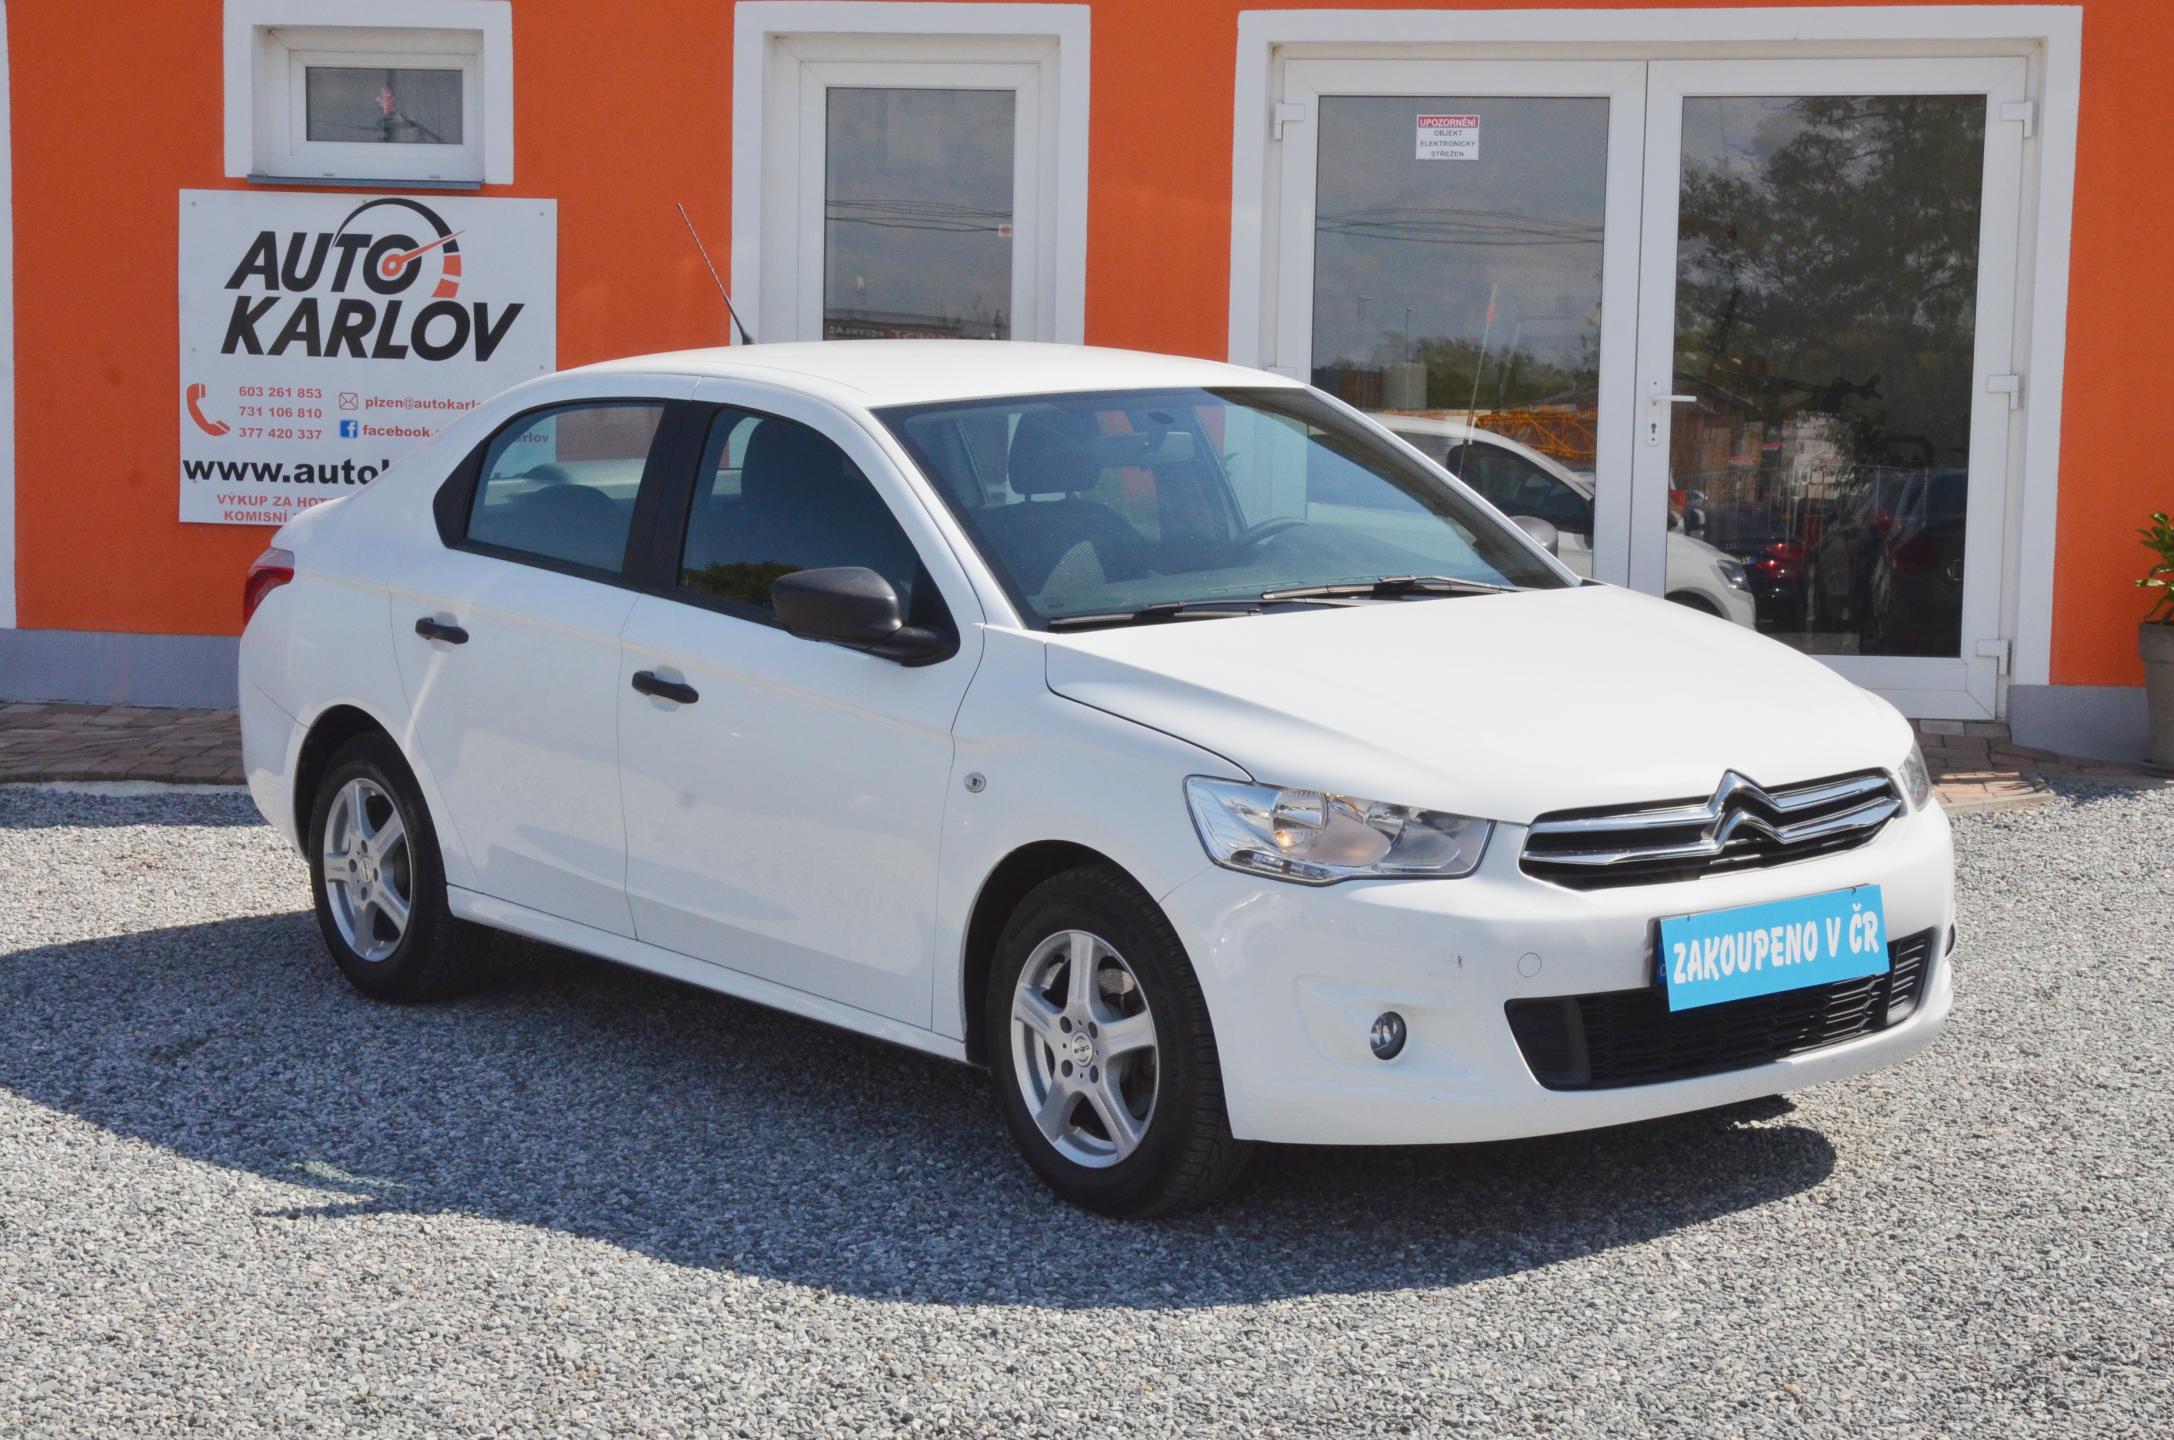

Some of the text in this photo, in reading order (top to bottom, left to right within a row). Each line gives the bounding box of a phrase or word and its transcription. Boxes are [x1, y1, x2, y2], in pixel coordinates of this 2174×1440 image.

[1420, 116, 1476, 127] UPOZORNĚNÍ
[1433, 129, 1463, 137] OBJEKT
[1419, 140, 1476, 148] ELEKTRONICKY
[224, 230, 422, 295] AUTO
[220, 295, 525, 362] KARLOV
[239, 386, 322, 399] 603 261 853
[365, 396, 480, 410] plzen@autokarl
[239, 406, 322, 419] 731 106 810
[239, 427, 322, 440] 377 420 337
[363, 424, 439, 438] facebook.
[182, 458, 390, 485] www.auto
[217, 492, 336, 507] VÝKUP ZA HOT
[223, 509, 288, 522] KOMISNÍ
[1672, 902, 1880, 985] ZAKOUPENO V ČR
